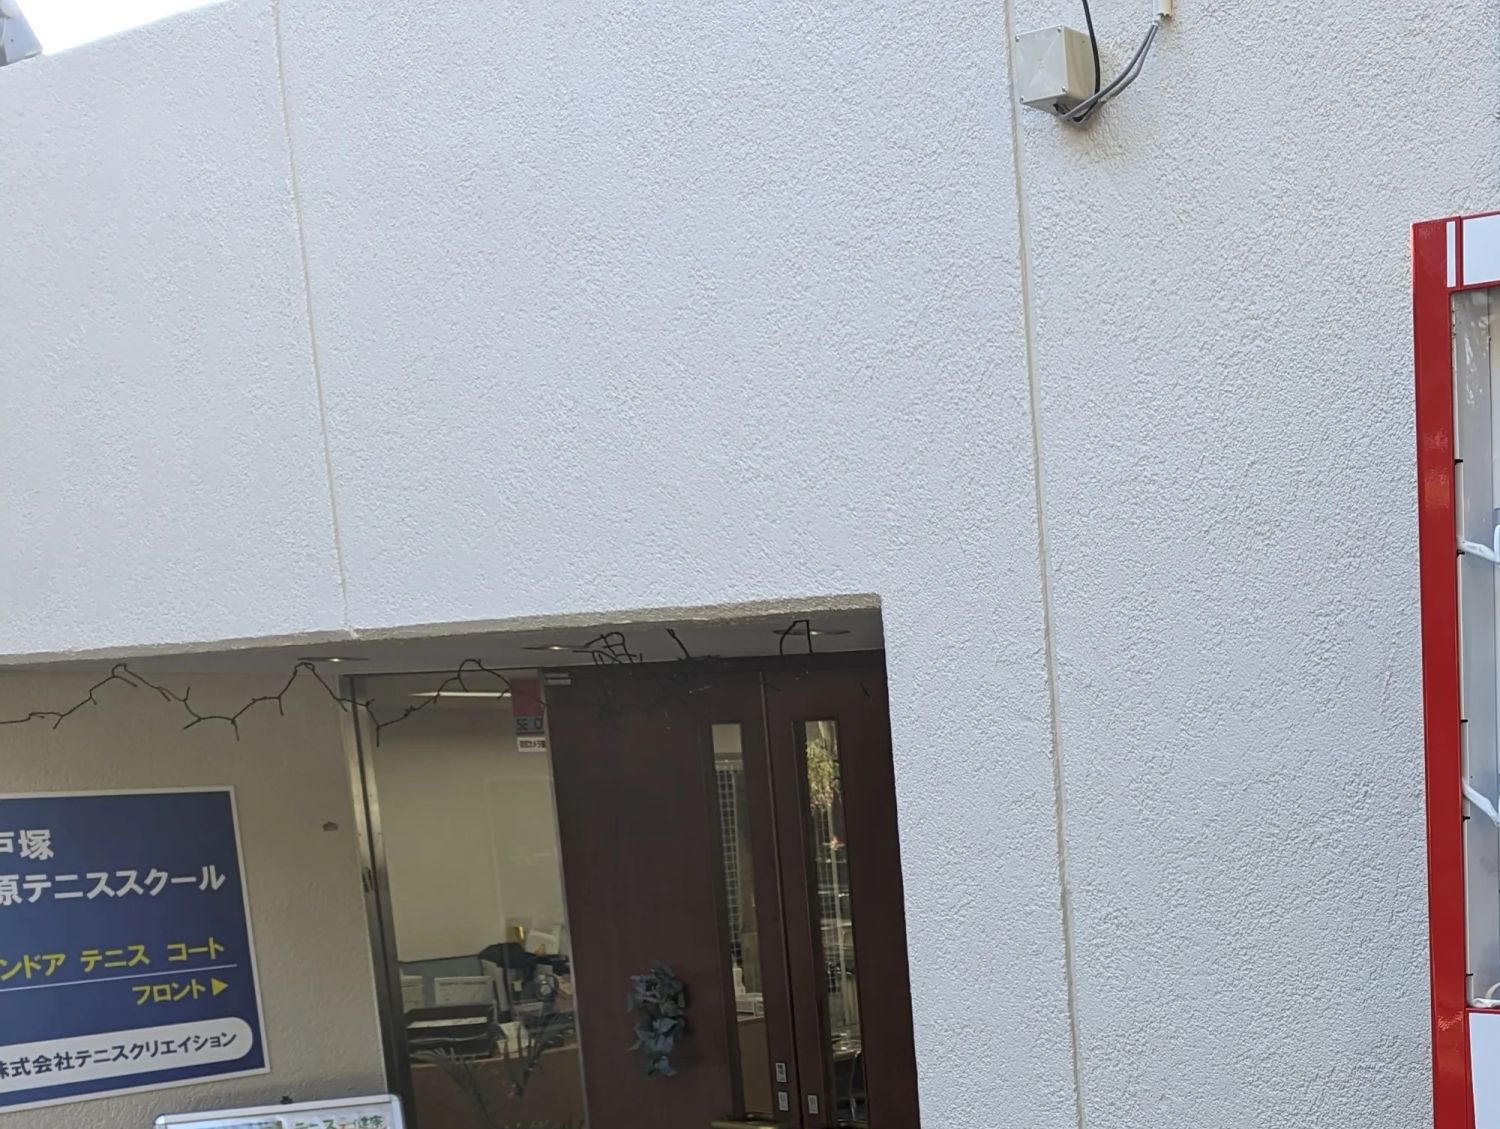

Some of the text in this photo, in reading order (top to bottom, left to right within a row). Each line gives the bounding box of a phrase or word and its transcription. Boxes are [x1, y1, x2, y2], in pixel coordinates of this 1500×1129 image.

[0, 865, 226, 906] 原テニススクール
[80, 944, 150, 972] テニス
[167, 937, 225, 962] コート
[132, 978, 206, 1005] フロント
